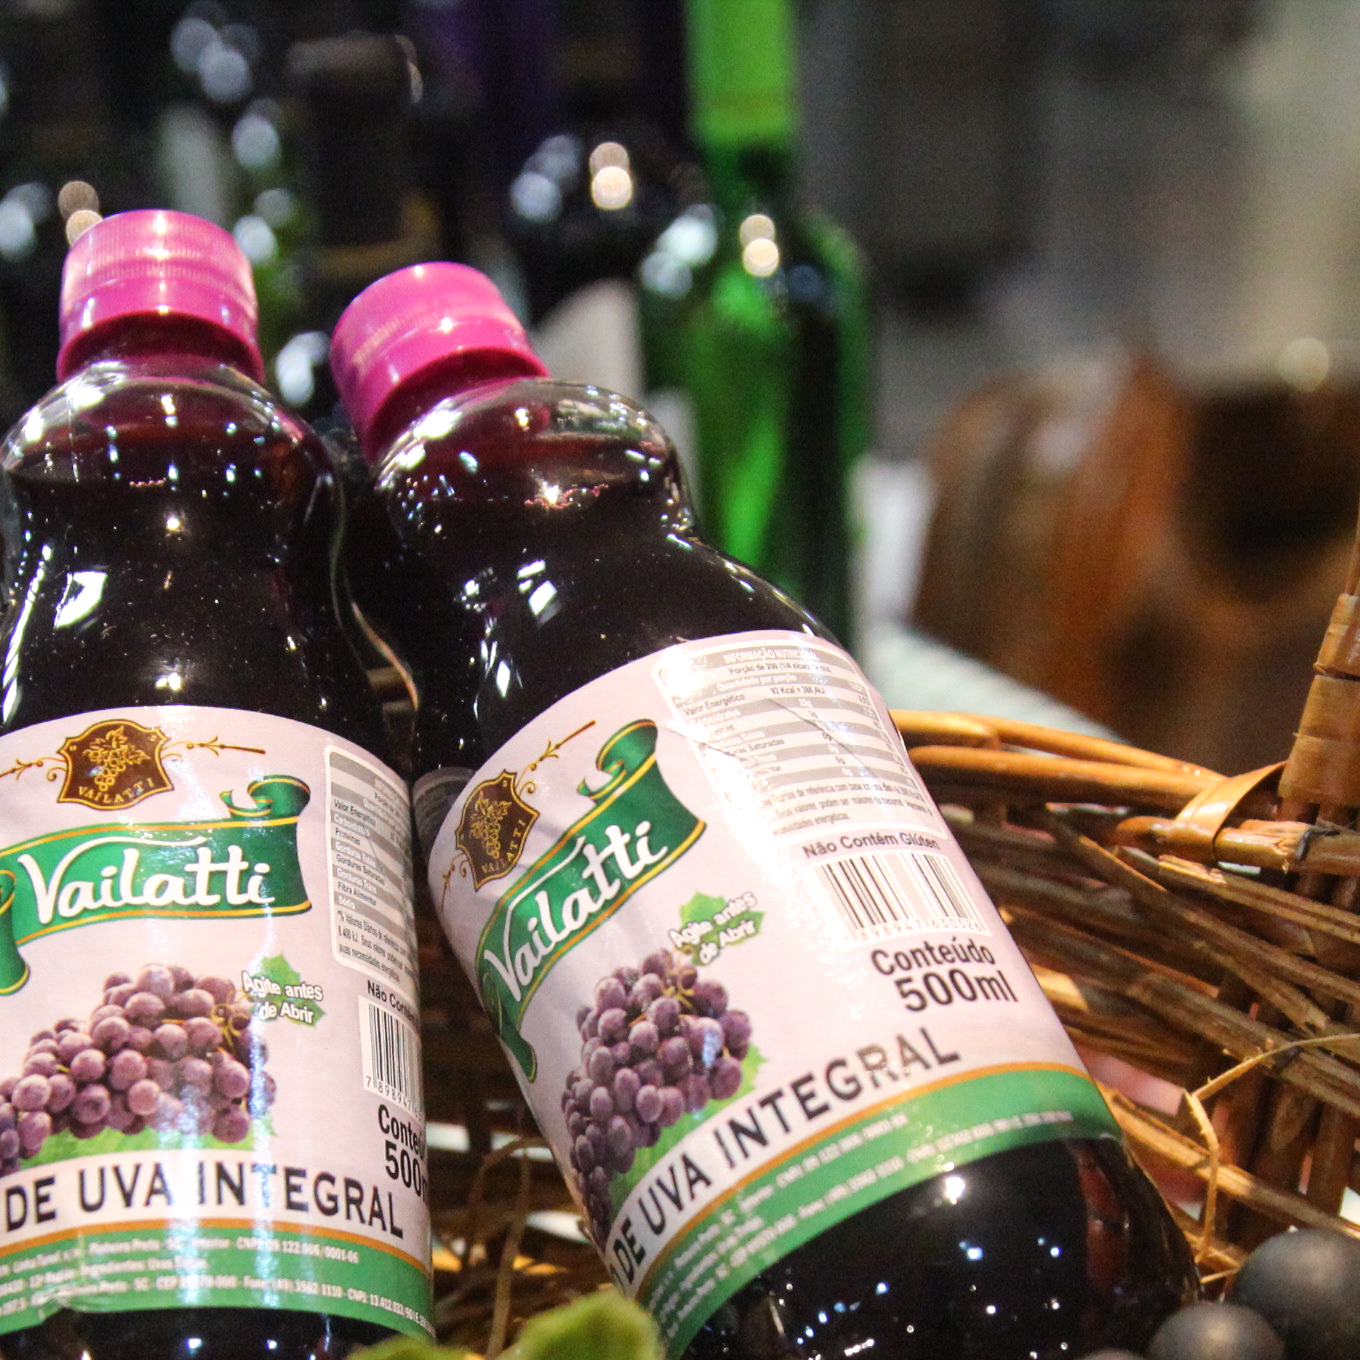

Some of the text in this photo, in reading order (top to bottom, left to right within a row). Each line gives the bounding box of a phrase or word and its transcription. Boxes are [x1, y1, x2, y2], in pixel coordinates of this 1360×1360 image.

[79, 777, 155, 804] VAILATTI
[334, 799, 349, 814] Valor
[481, 819, 526, 874] VAILATTI
[802, 831, 941, 858] Não Contém Glúten
[17, 836, 276, 925] Vailatti
[484, 820, 669, 1002] Vailatti
[712, 892, 757, 922] antes
[699, 920, 757, 965] de Abrir
[871, 936, 997, 976] Conteúdo
[241, 970, 324, 1002] Agite antes
[367, 980, 388, 1003] Não
[894, 968, 1019, 1012] 500ml
[258, 1001, 315, 1025] de Abrir
[613, 1216, 646, 1285] DE
[638, 1153, 712, 1237] UVA
[713, 1027, 962, 1170] INTEGRAL
[6, 1177, 58, 1233] DE
[78, 1160, 175, 1213] UVA
[196, 1162, 404, 1240] INTEGRAL
